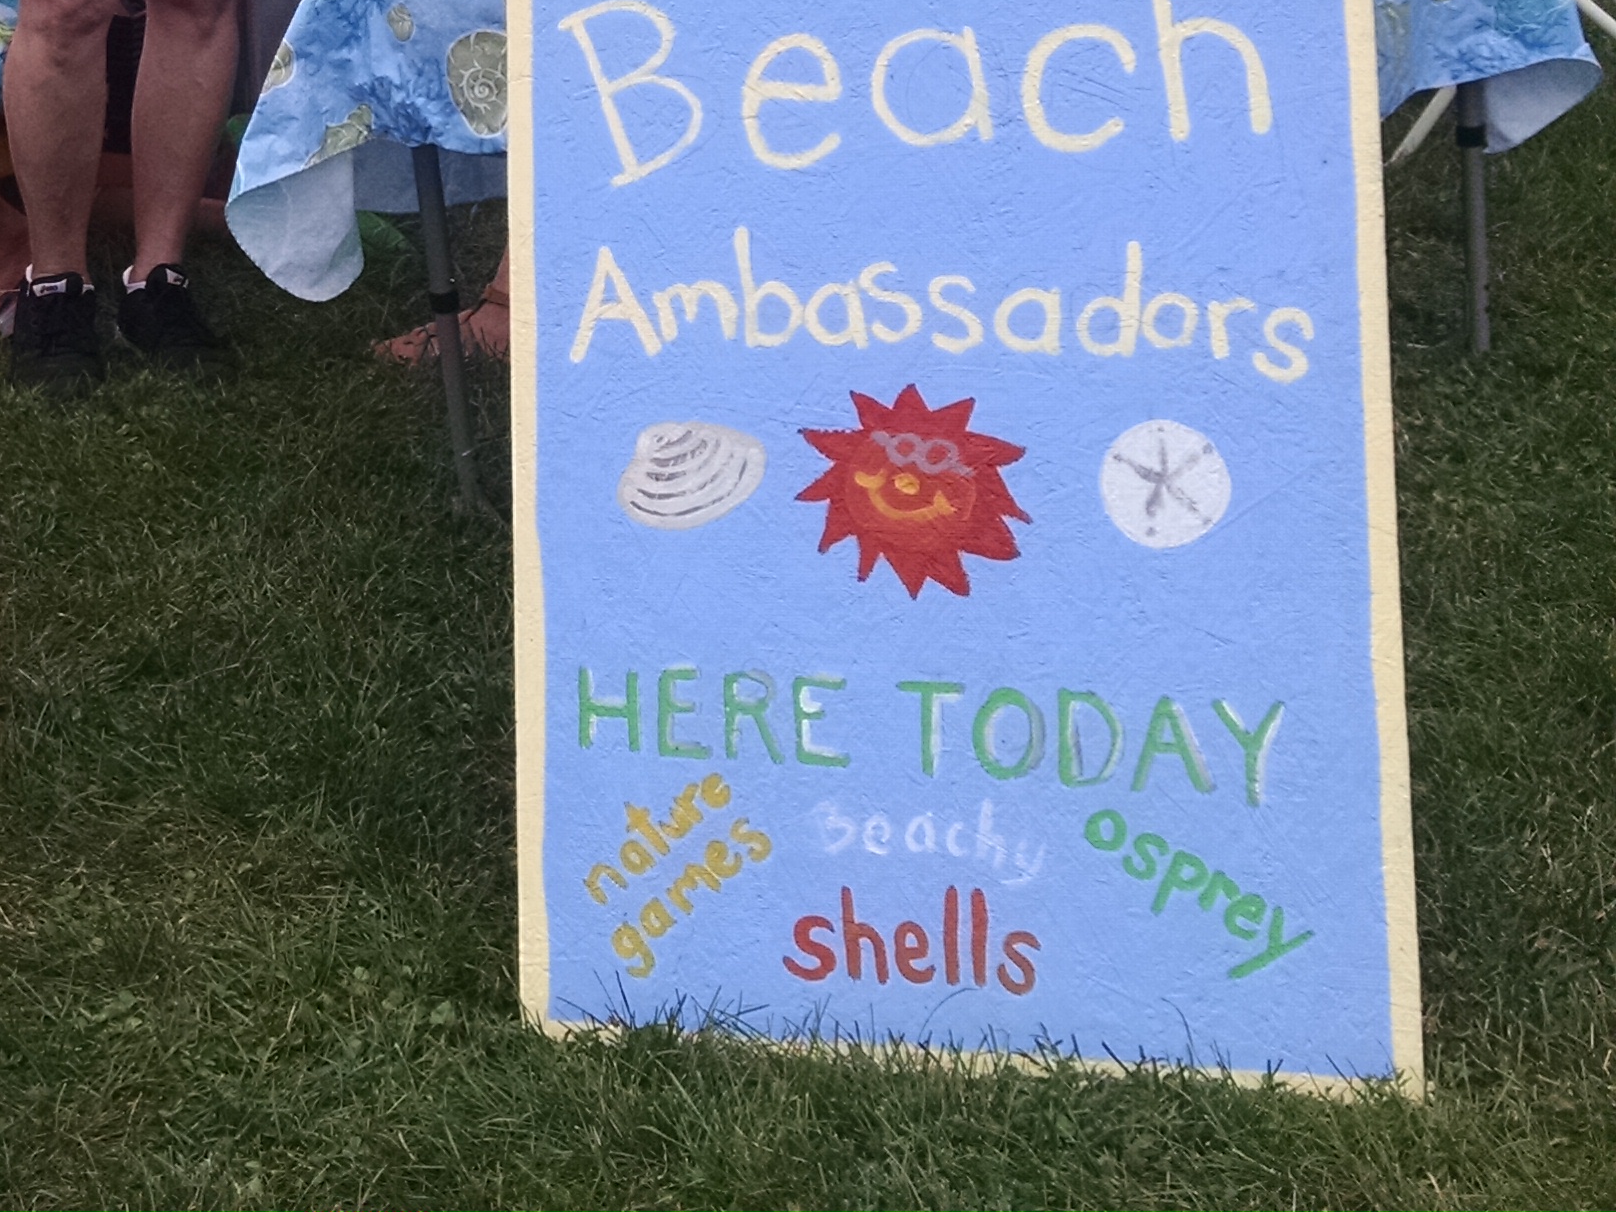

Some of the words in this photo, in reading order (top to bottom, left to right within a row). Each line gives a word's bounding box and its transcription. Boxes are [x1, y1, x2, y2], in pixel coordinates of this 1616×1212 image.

[570, 224, 1316, 384] Ambassadors
[577, 665, 852, 769] HERE
[895, 680, 1288, 809] TODAY
[583, 772, 732, 907] nature
[609, 817, 773, 980] games
[1084, 808, 1317, 981] osprey
[781, 884, 1043, 996] shells
